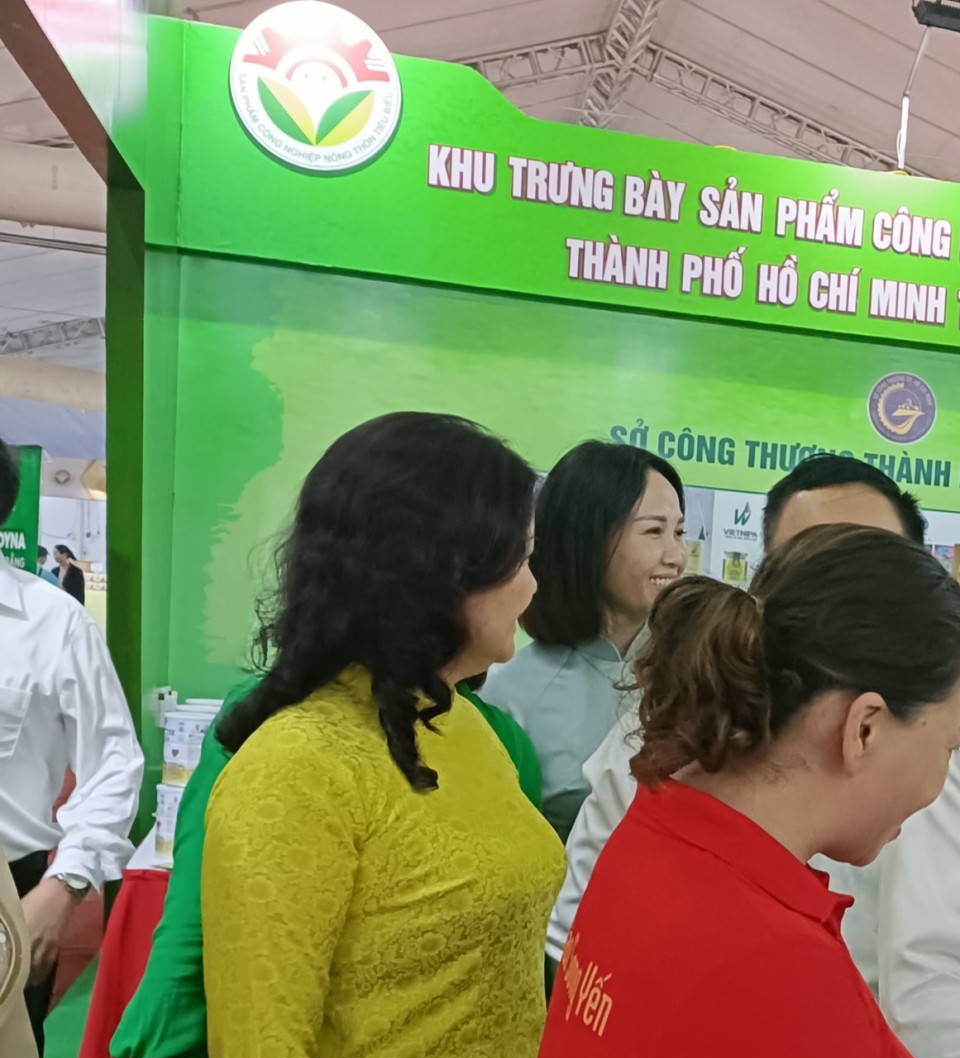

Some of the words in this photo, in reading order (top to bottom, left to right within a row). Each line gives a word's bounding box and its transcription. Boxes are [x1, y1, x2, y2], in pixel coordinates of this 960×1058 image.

[428, 144, 496, 194] KHU
[508, 155, 614, 212] TRƯNG
[623, 170, 687, 222] BÀY
[698, 176, 764, 234] SẢN
[775, 188, 865, 249] PHẨM
[872, 205, 952, 259] CÔNG
[566, 234, 669, 290] THÀNH
[681, 246, 747, 298] PHỐ
[757, 254, 798, 306] HỒ
[809, 268, 862, 315] CHÍ
[869, 278, 947, 325] MINH
[610, 418, 649, 450] SỞ
[658, 427, 735, 467] CÔNG
[864, 450, 951, 488] THÀNH
[575, 960, 613, 1037] Yến
